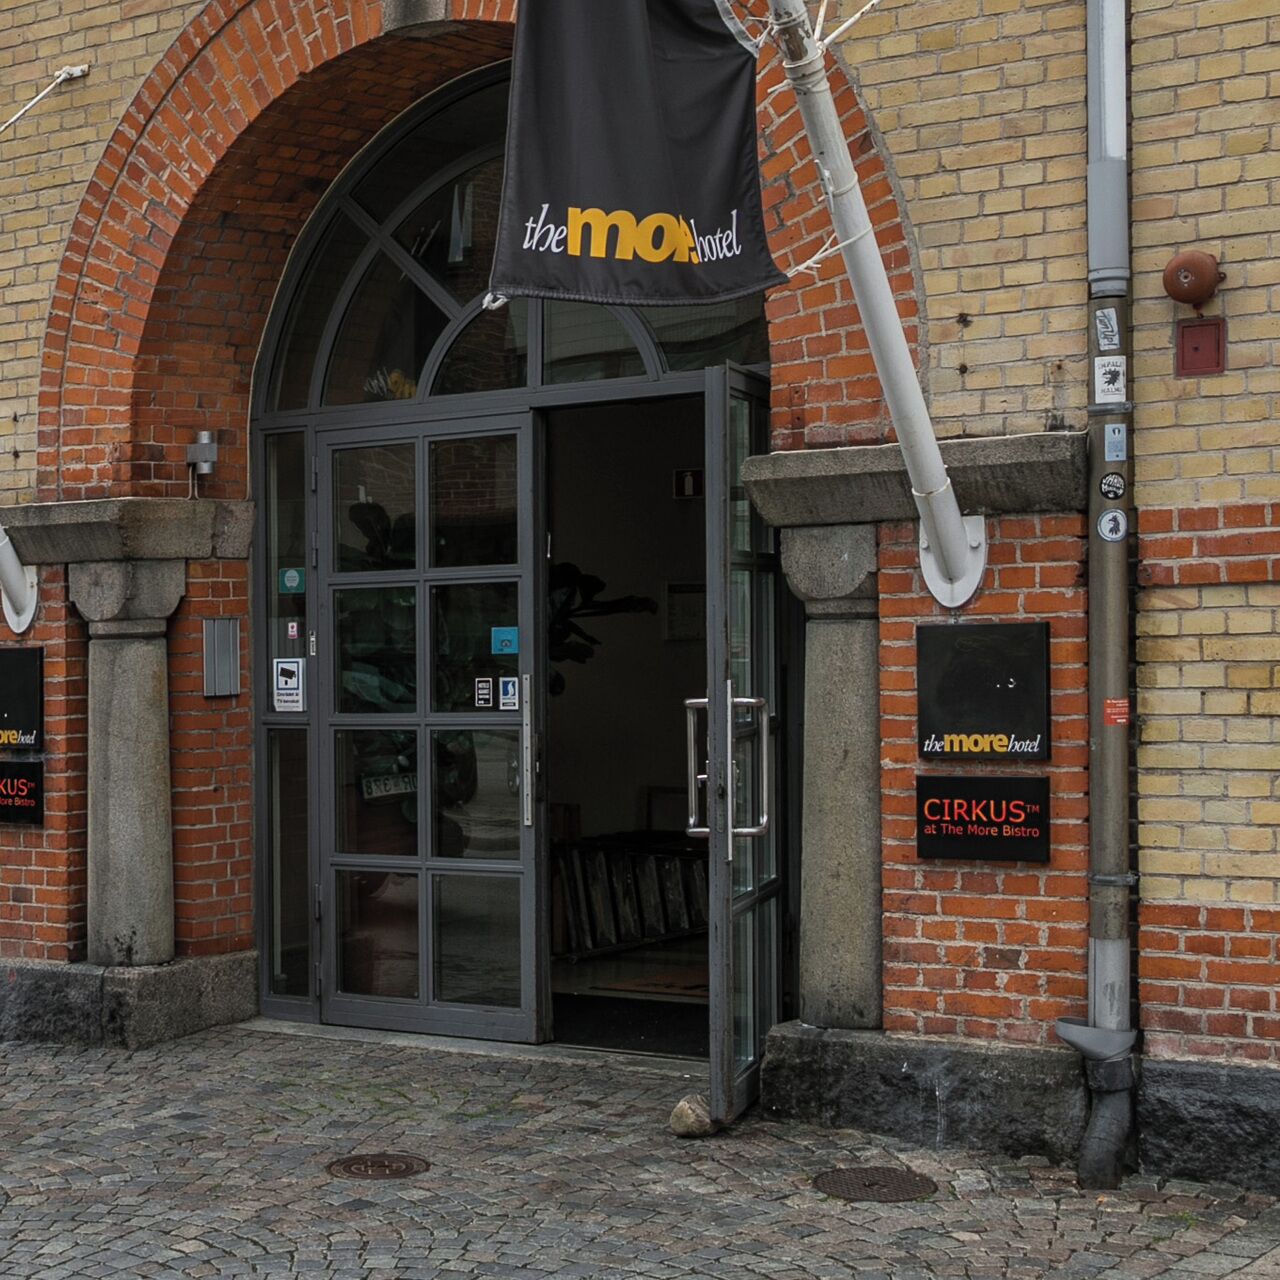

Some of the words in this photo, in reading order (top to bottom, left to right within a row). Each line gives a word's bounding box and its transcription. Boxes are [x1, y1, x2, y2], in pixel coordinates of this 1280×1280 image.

[923, 825, 937, 835] at
[940, 823, 964, 835] The
[967, 824, 999, 837] More
[1002, 825, 1040, 838] Bistro
